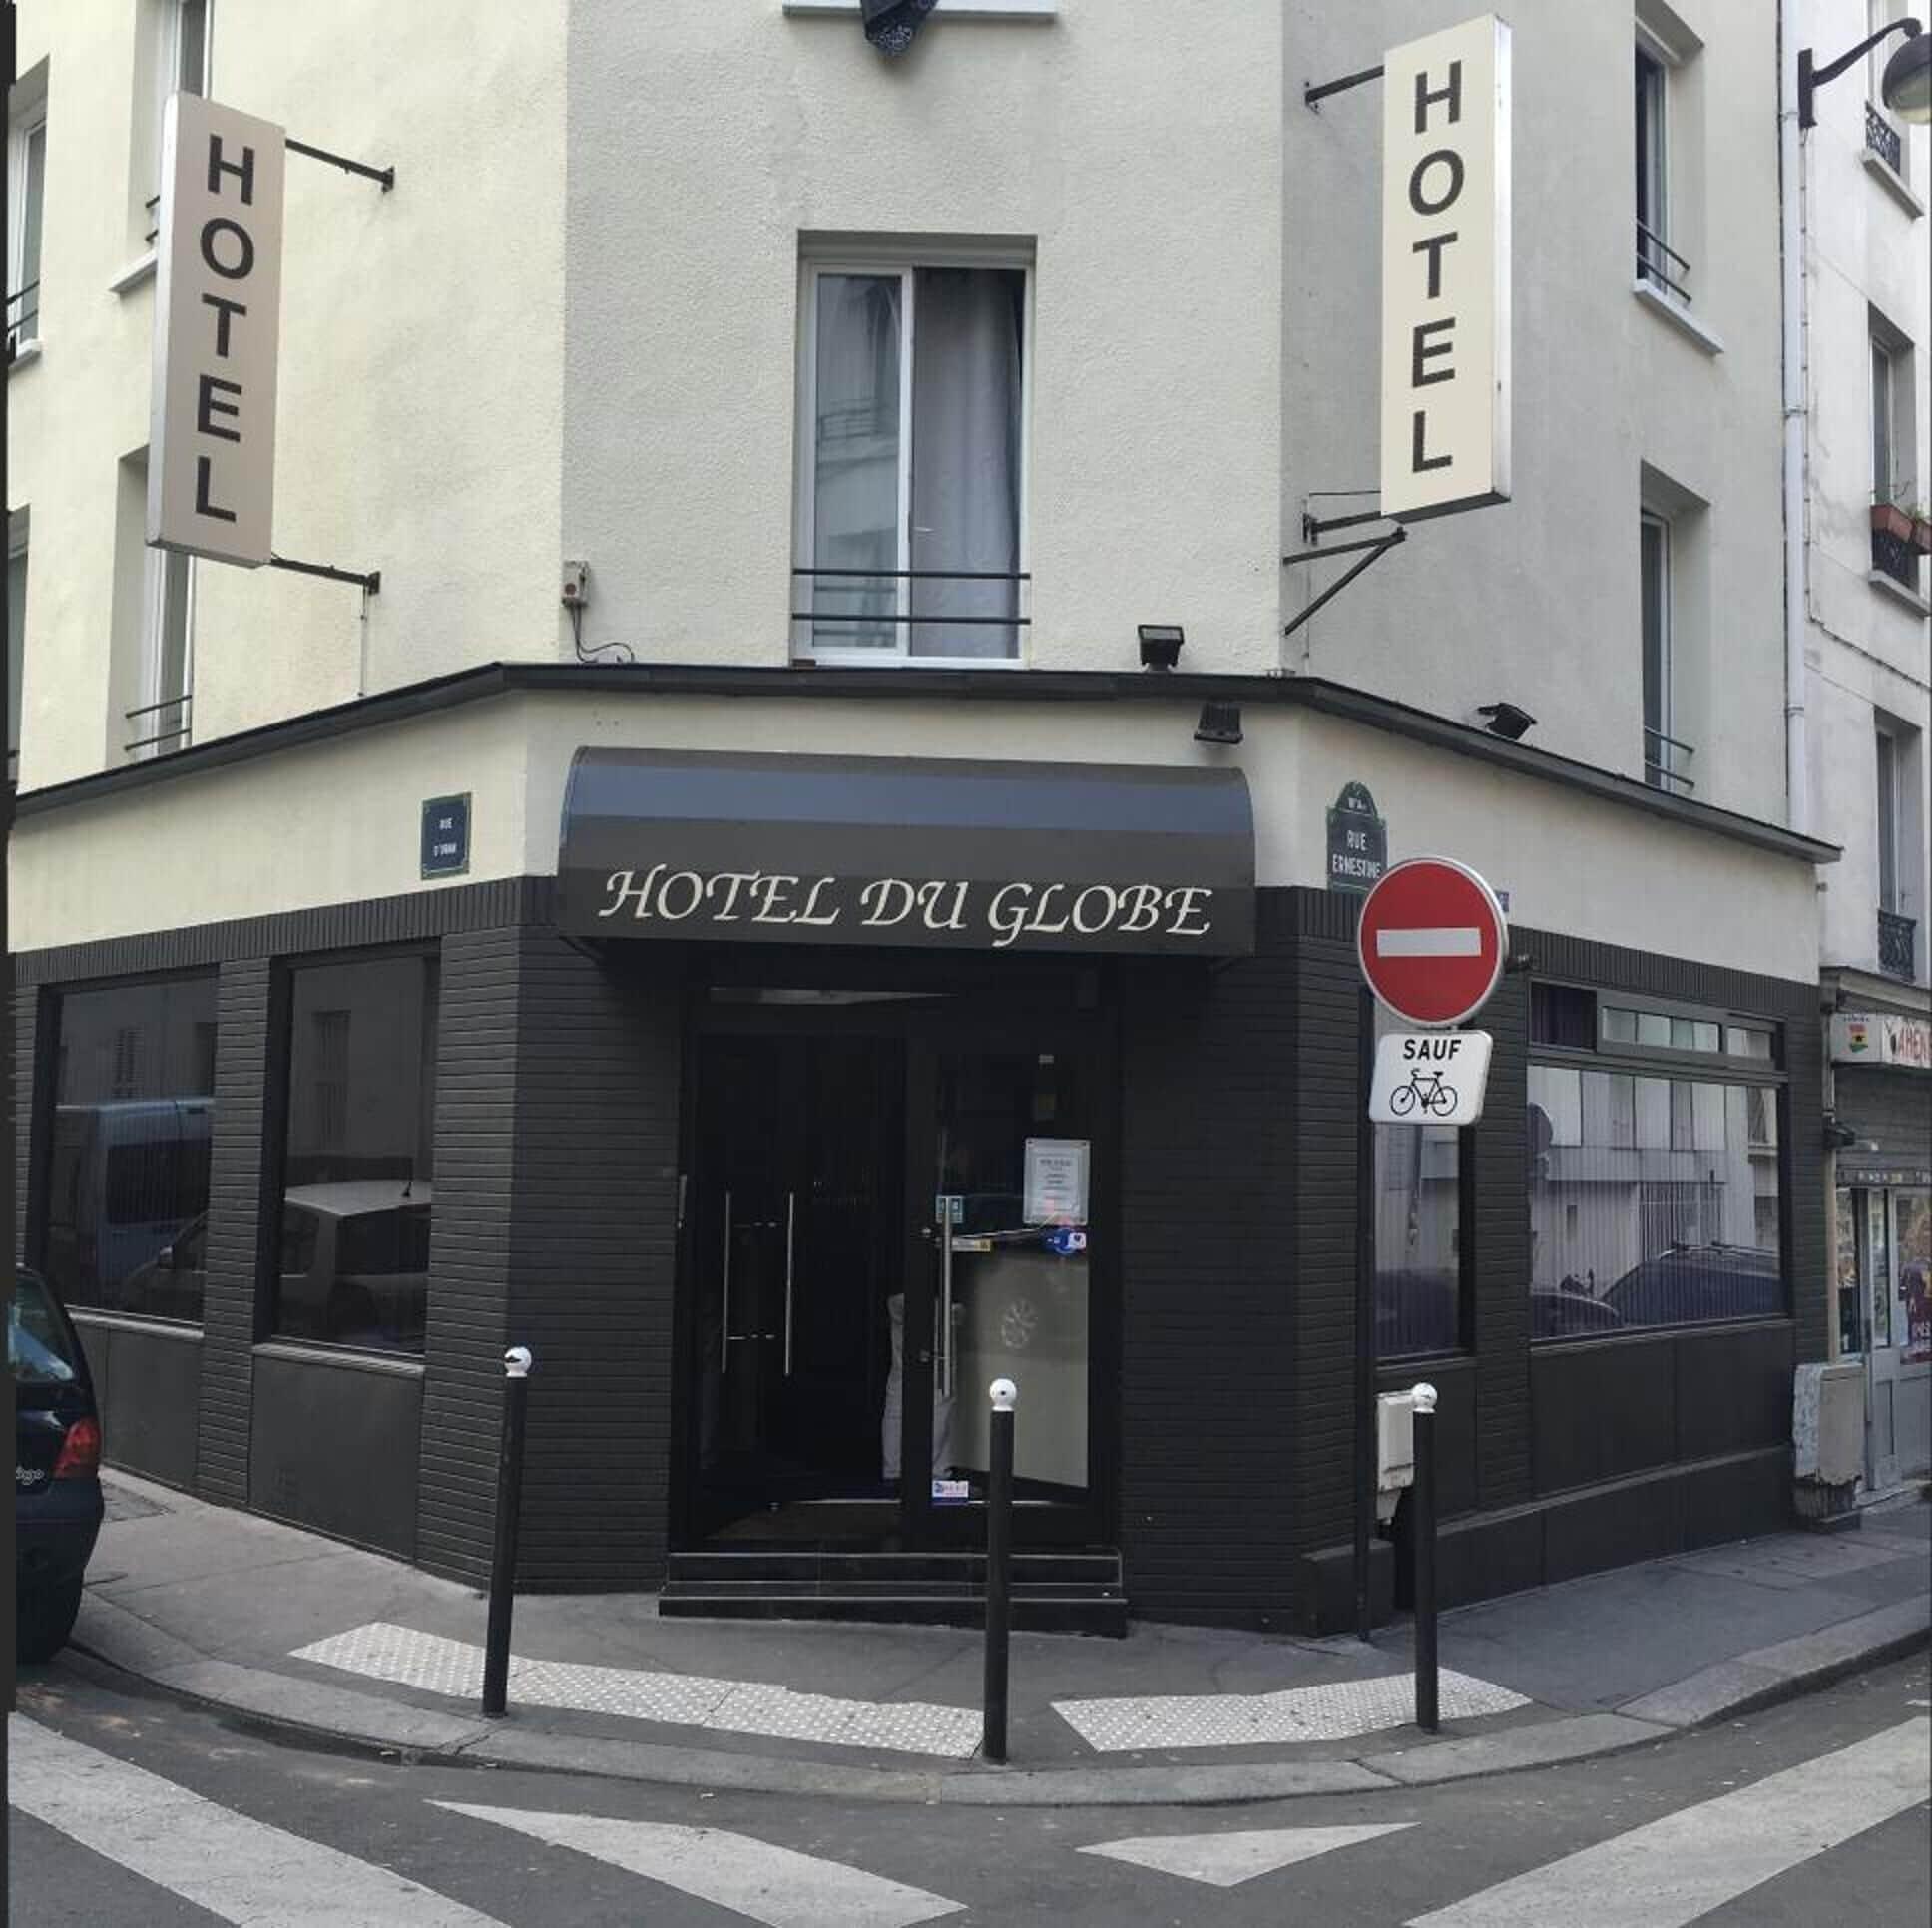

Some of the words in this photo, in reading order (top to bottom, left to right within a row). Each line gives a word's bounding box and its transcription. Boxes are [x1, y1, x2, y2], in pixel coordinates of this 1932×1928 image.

[1408, 60, 1465, 474] HOTEL
[194, 134, 255, 523] HOTEL
[1347, 829, 1366, 851] RUE
[599, 863, 840, 925] HOTEL
[860, 878, 968, 930] DU
[988, 882, 1213, 948] GLOBE
[1403, 1038, 1461, 1060] SAUF
